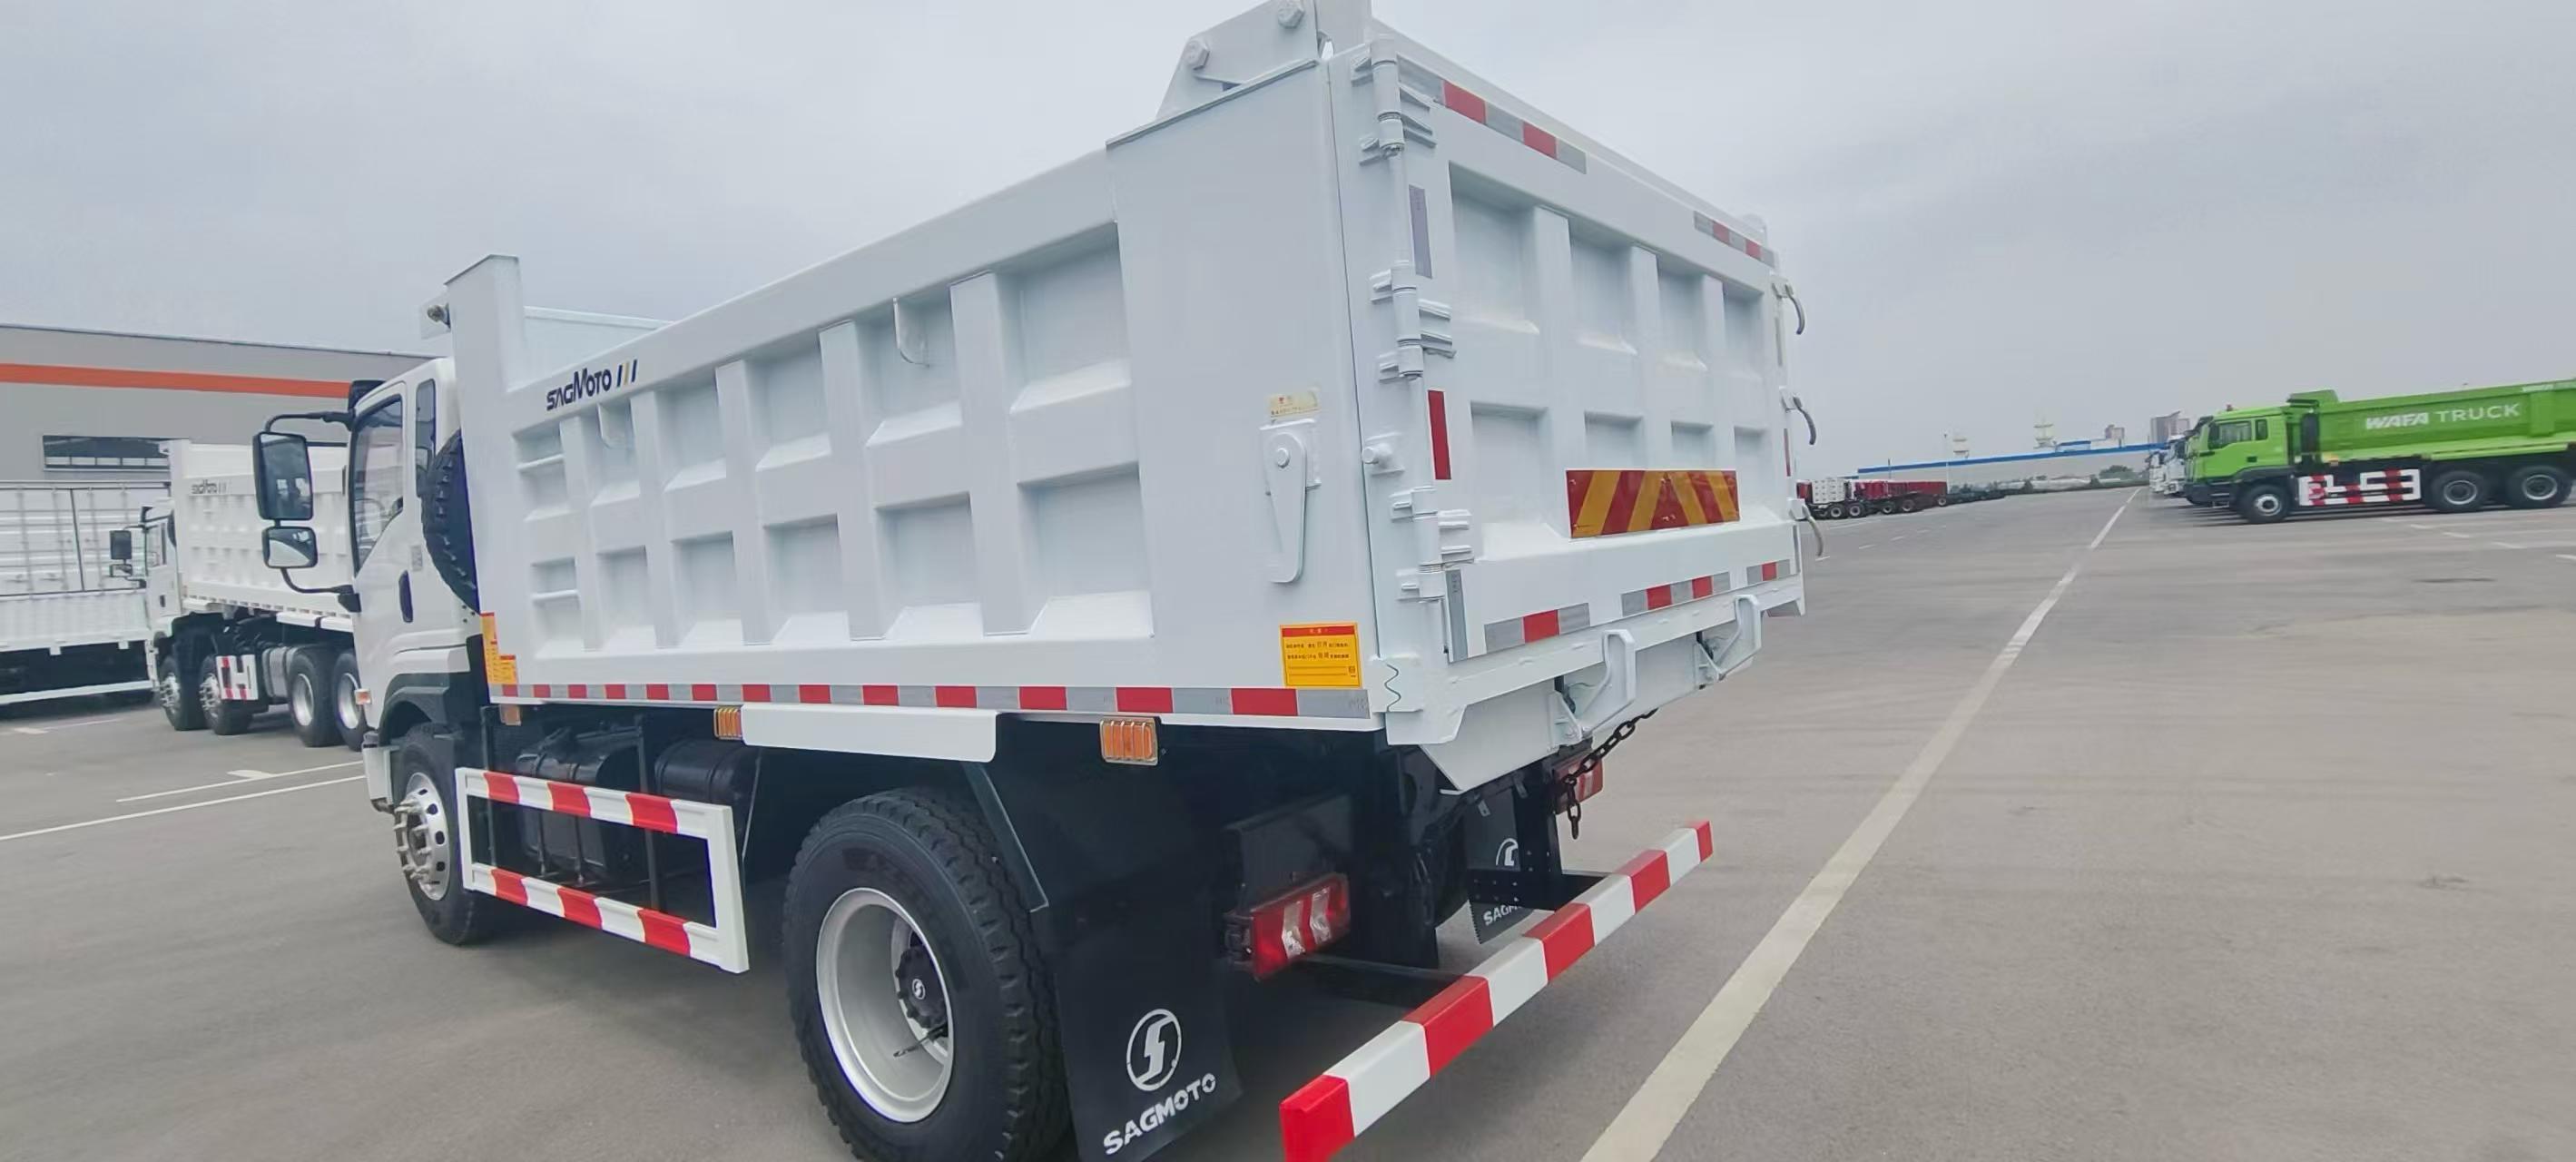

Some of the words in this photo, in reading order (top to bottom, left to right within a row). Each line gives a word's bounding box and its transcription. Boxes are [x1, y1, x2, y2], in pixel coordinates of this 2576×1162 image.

[546, 368, 613, 411] SAGMOTO
[2365, 412, 2430, 429] WAFA
[2436, 403, 2522, 423] TRUCK
[1483, 904, 1523, 926] SAG
[1103, 1072, 1216, 1155] SAGMOTO
